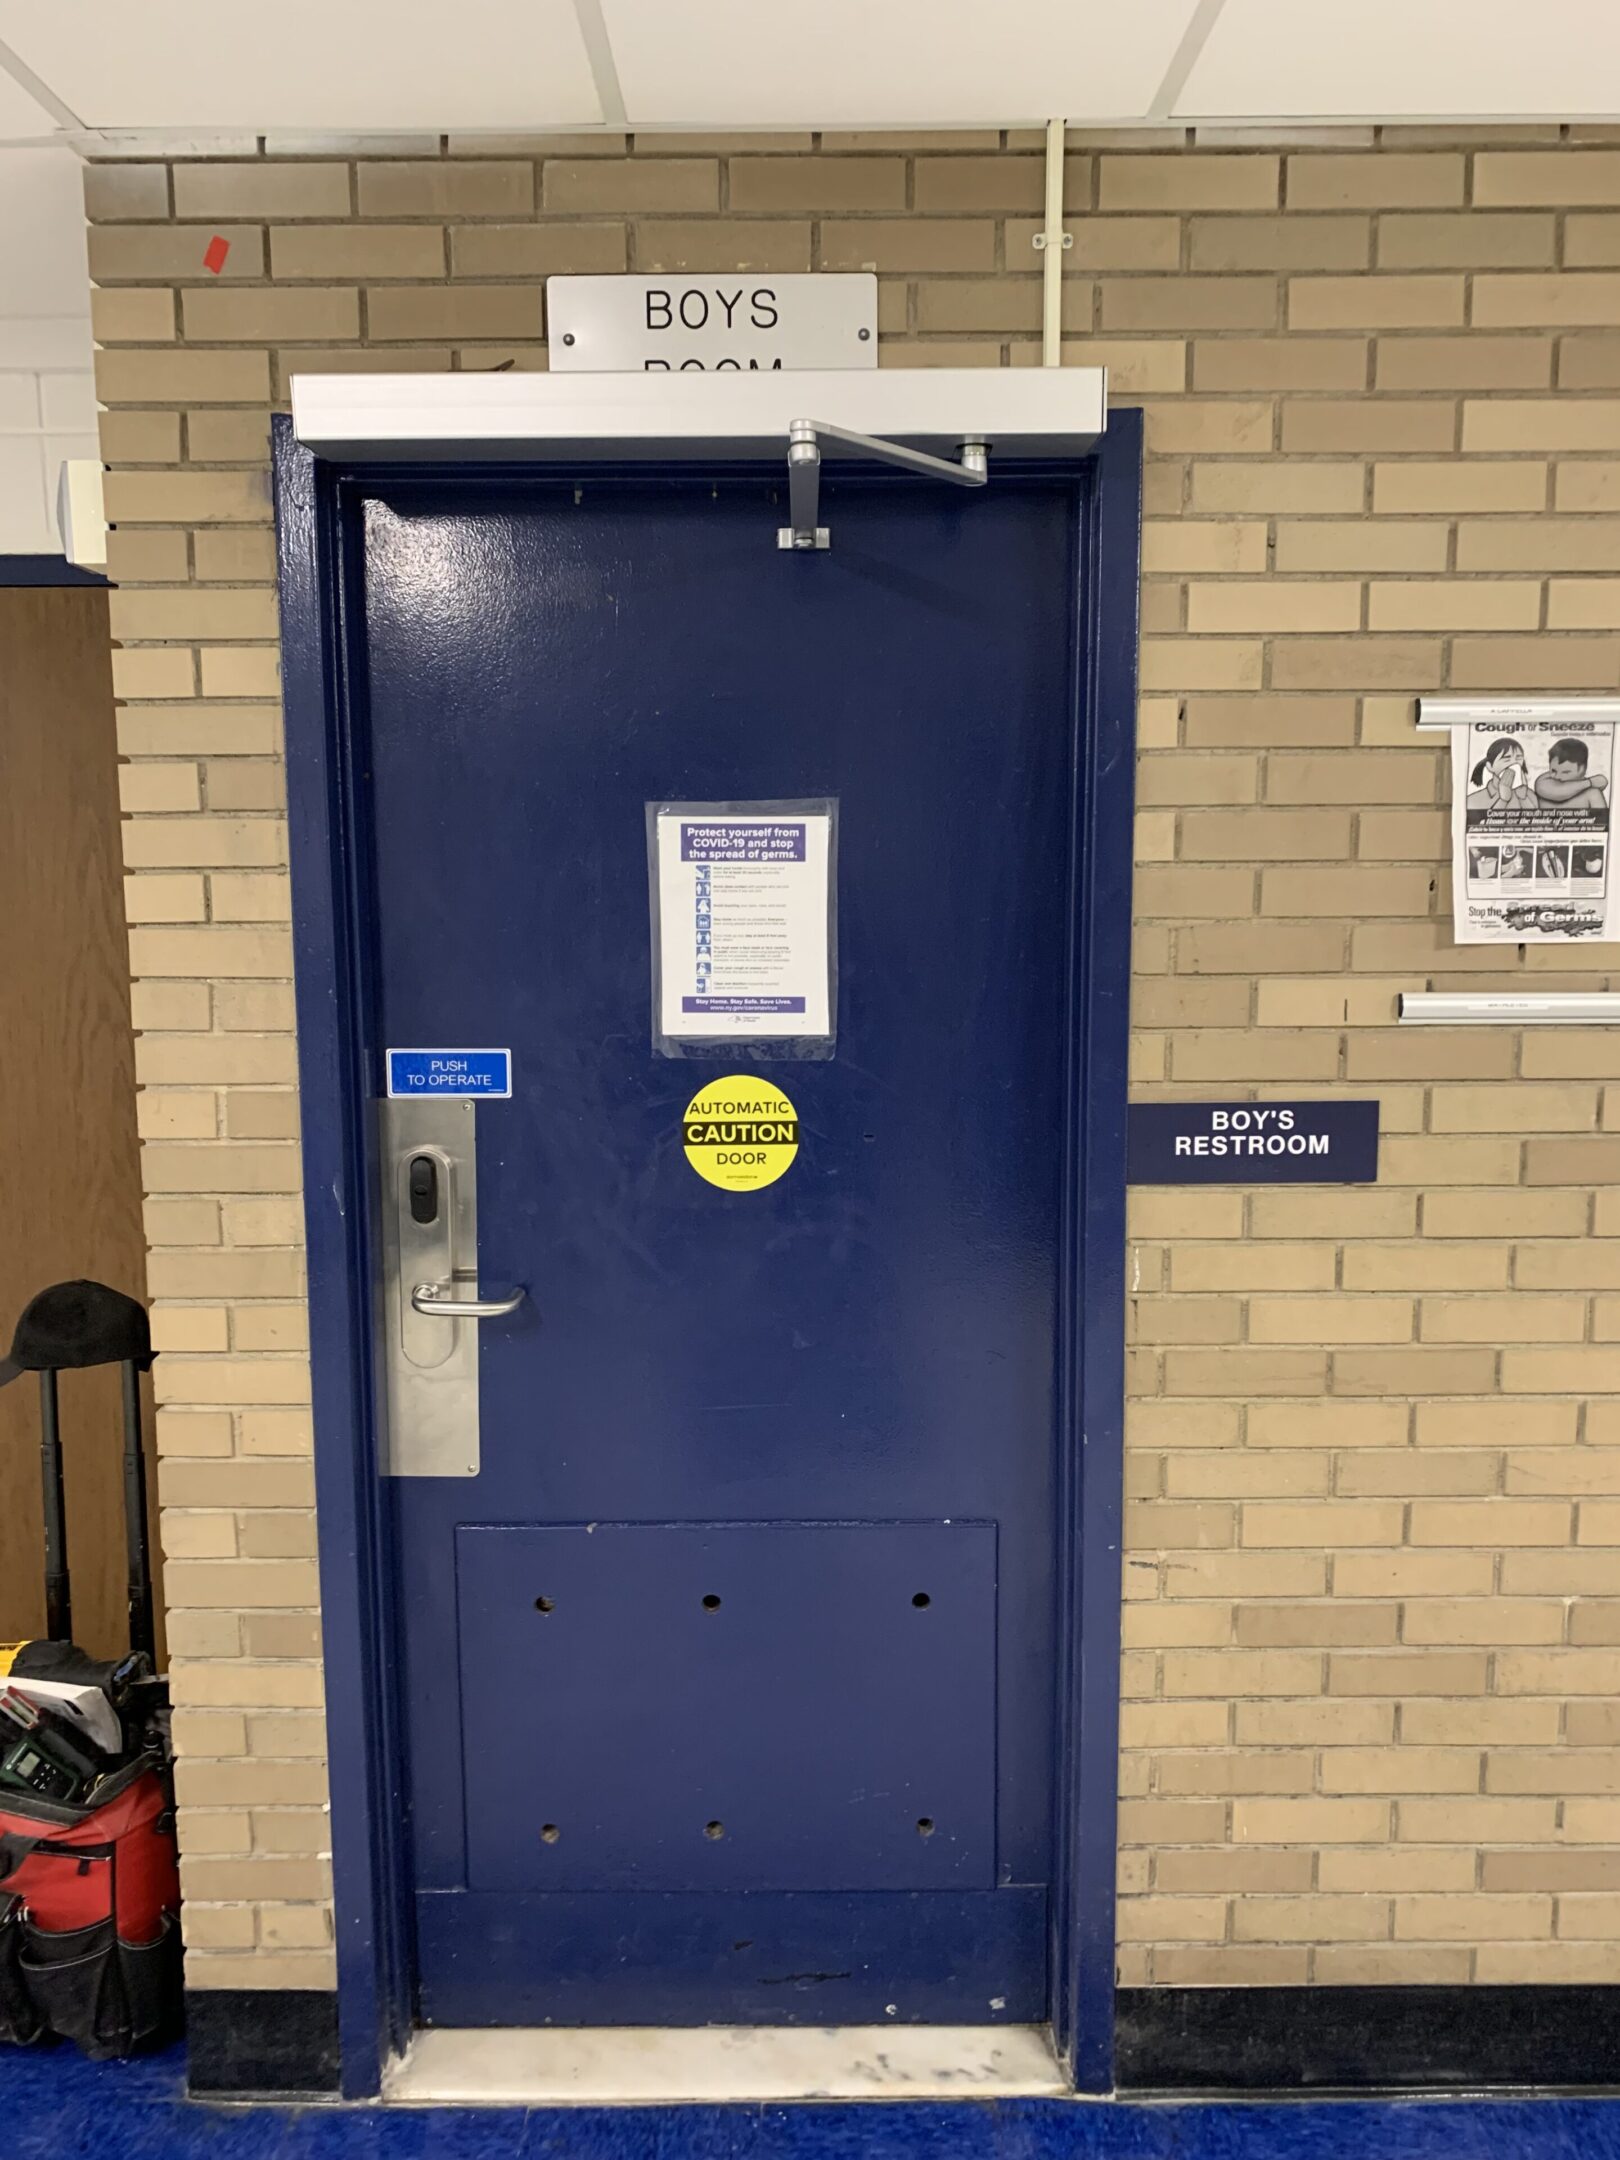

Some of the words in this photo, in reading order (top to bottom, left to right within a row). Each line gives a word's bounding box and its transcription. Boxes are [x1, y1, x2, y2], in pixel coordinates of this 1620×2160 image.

[645, 288, 779, 330] BOYS
[1475, 722, 1525, 734] Cough
[1539, 722, 1595, 732] Sneeze
[1486, 809, 1506, 818] Cover
[1506, 810, 1521, 819] your
[1521, 809, 1542, 817] mouth
[1543, 809, 1556, 817] and
[1531, 817, 1552, 825] inside
[687, 827, 726, 837] Protect
[728, 827, 772, 840] yourself
[774, 827, 800, 837] from
[693, 839, 745, 848] COVID-19
[747, 839, 769, 848] and
[770, 840, 794, 850] stop
[689, 849, 707, 859] the
[709, 849, 746, 861] spread
[748, 849, 760, 859] of
[761, 850, 798, 861] germs.
[1468, 906, 1486, 919] Stop
[1487, 906, 1502, 916] the
[1524, 911, 1535, 922] of
[1540, 911, 1603, 922] Germs
[431, 1060, 467, 1072] PUSH
[407, 1074, 425, 1086] TO
[428, 1074, 492, 1086] OPERATE
[689, 1101, 790, 1115] AUTOMATIC
[1212, 1109, 1295, 1131] BOY'S
[687, 1123, 794, 1143] CAUTION
[1175, 1134, 1330, 1156] RESTROOM
[716, 1152, 767, 1165] DOOR
